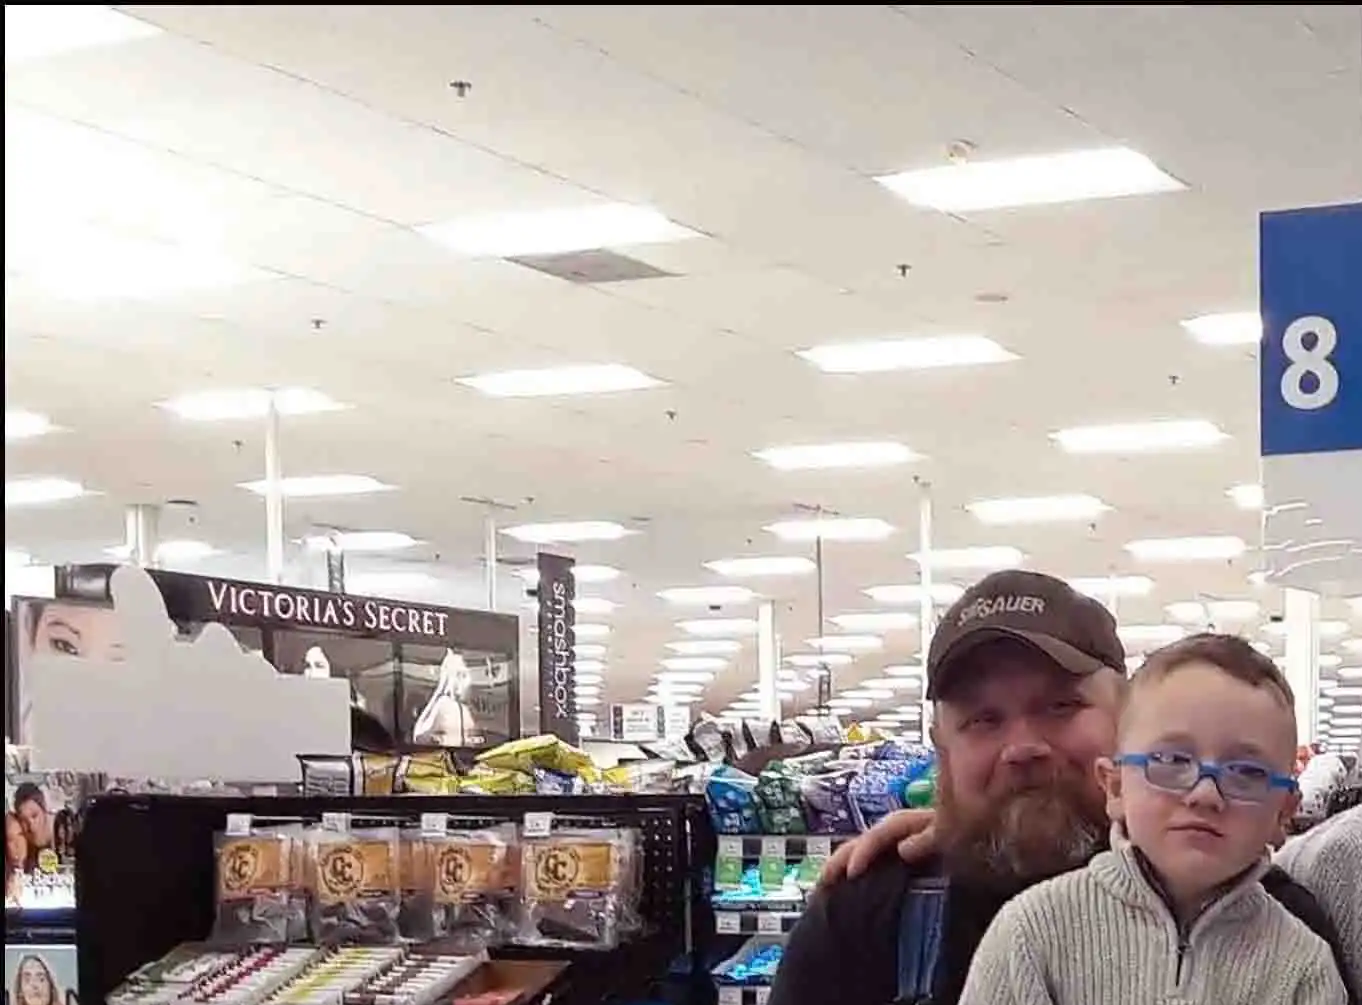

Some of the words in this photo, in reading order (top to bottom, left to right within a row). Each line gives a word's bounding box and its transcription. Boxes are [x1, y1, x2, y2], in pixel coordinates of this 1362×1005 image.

[1281, 315, 1340, 410] 8
[207, 581, 354, 627] VICTORIA'S
[364, 600, 449, 637] SECRET
[552, 580, 572, 720] smashbox
